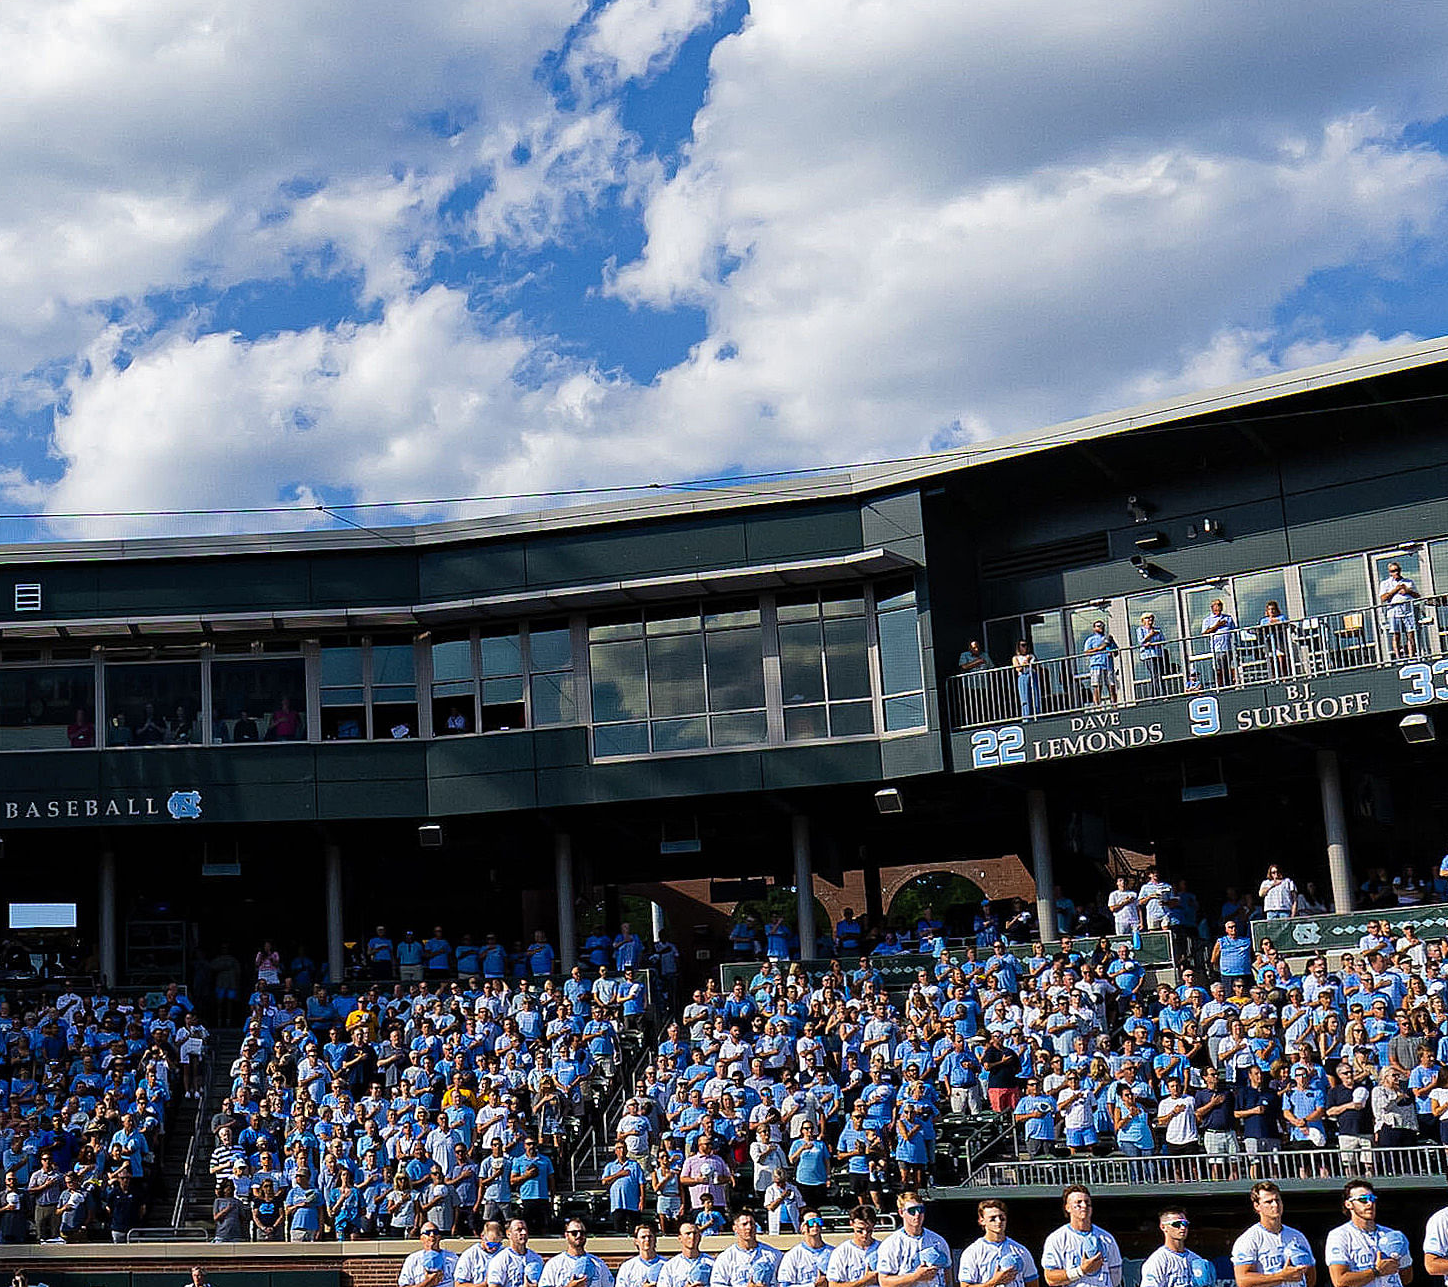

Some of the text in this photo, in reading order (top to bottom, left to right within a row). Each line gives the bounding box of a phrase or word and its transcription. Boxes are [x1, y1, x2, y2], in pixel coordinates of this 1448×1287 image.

[1286, 684, 1316, 700] B.J.
[1070, 712, 1121, 732] DAVE
[1187, 696, 1221, 737] 9
[1237, 692, 1372, 731] SURHOFF
[972, 725, 1026, 770] 22
[1032, 723, 1164, 760] LEMONDS
[6, 798, 159, 819] BASEBALL
